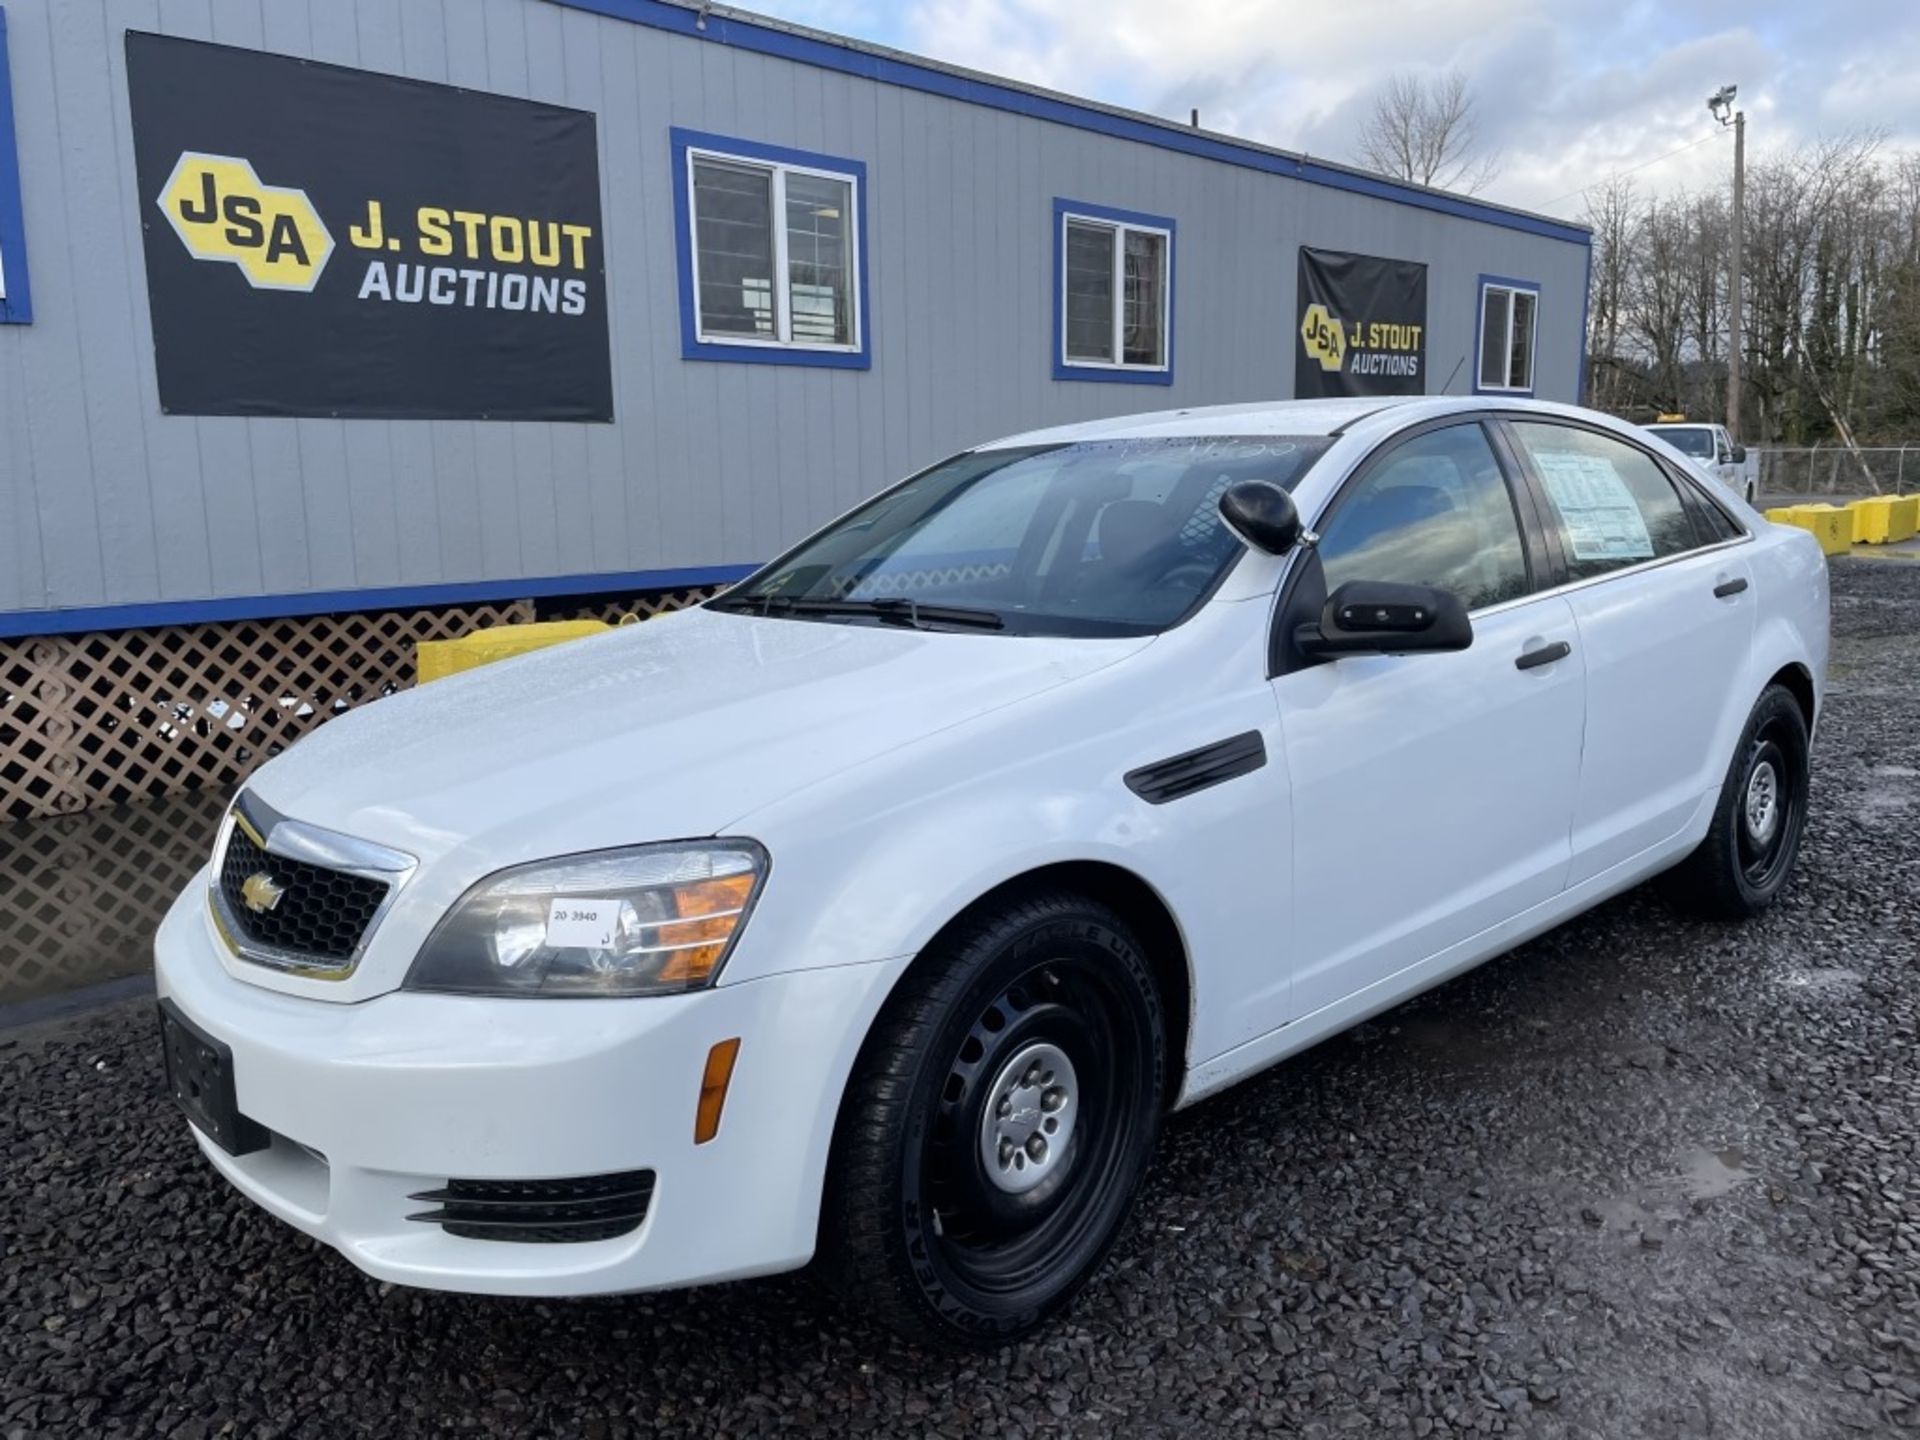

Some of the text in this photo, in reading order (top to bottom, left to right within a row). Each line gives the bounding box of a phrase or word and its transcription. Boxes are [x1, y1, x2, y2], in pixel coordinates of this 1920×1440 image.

[178, 172, 311, 266] JSA
[349, 200, 592, 270] J. STOUT
[358, 261, 586, 316] AUCTIONS
[1306, 313, 1340, 358] JSA
[1350, 322, 1422, 351] J. STOUT
[1350, 353, 1418, 376] AUCTIONS
